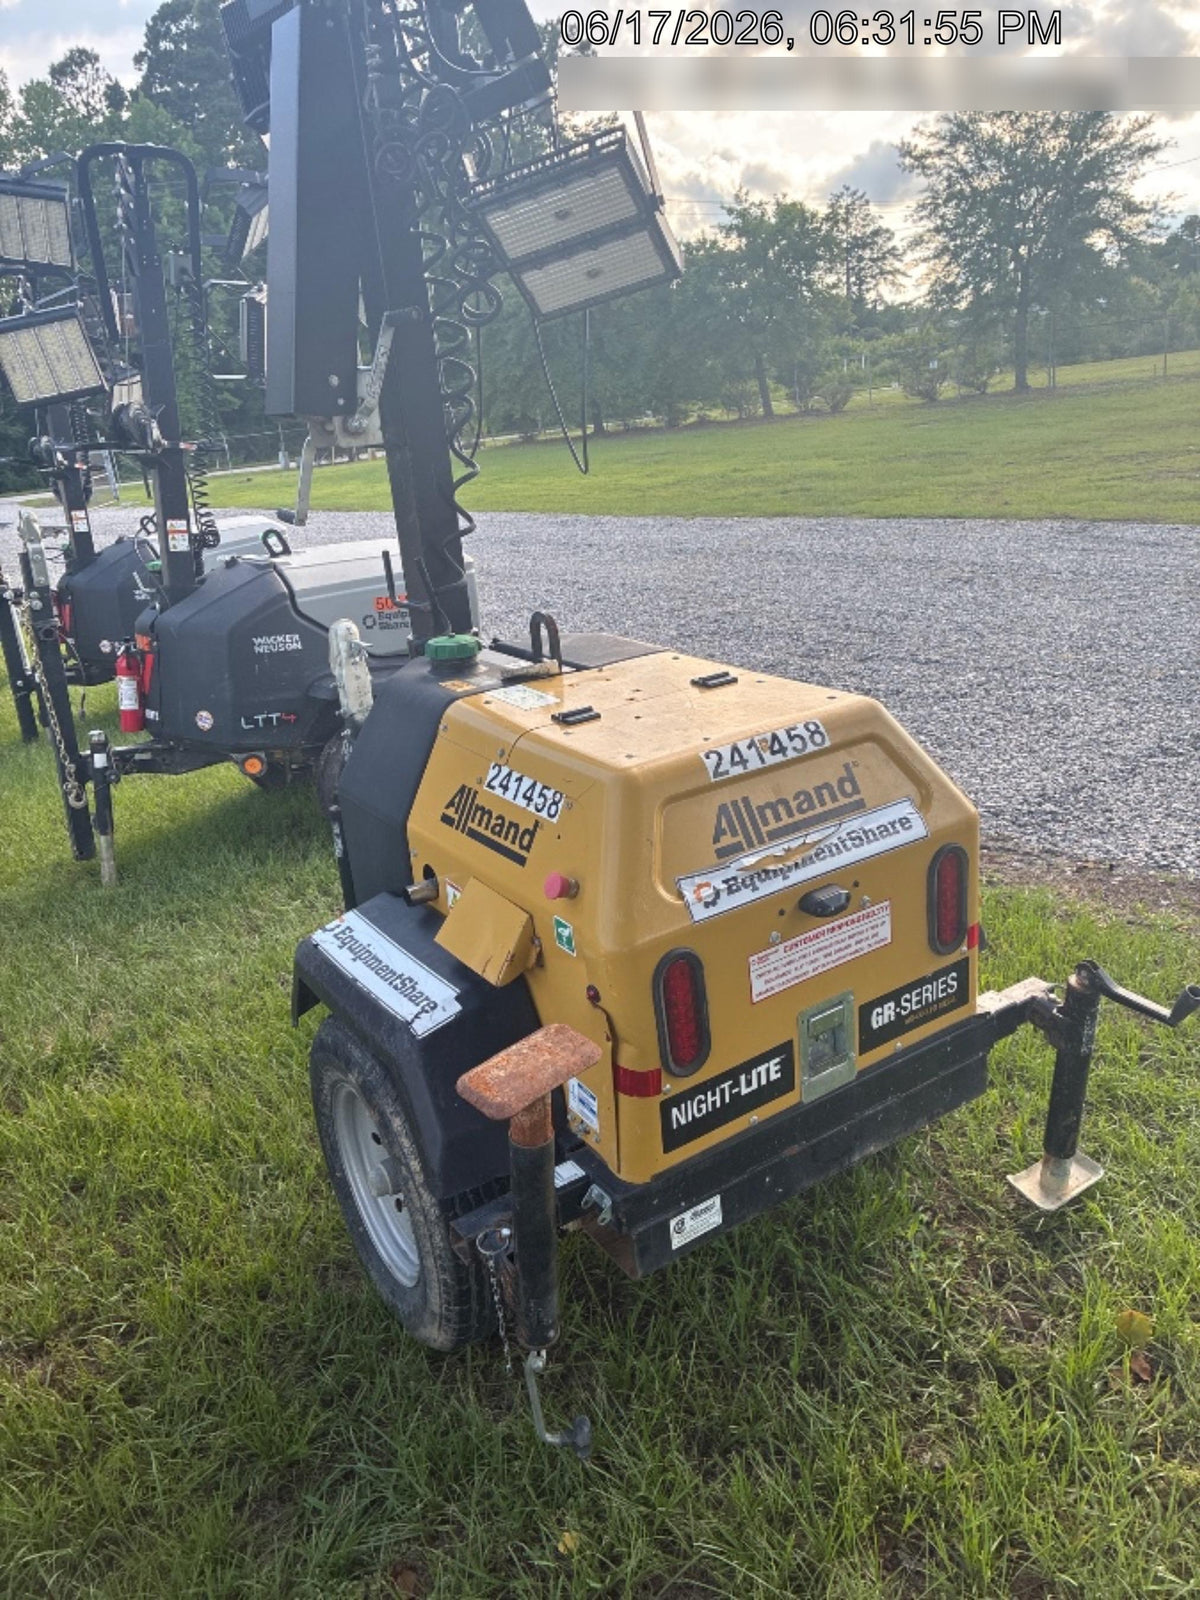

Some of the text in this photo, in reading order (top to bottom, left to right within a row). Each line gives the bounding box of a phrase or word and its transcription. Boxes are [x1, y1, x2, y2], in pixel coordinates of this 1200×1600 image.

[252, 634, 300, 645] WACKER
[254, 641, 302, 653] NEUSON
[705, 720, 827, 779] 241458
[443, 784, 541, 854] Allmand
[485, 763, 563, 819] 241458
[712, 762, 862, 850] Allmand
[332, 925, 439, 1014] EquipmentShare
[870, 971, 958, 1030] GR-SERIES
[671, 1056, 782, 1130] NIGHT-LITE
